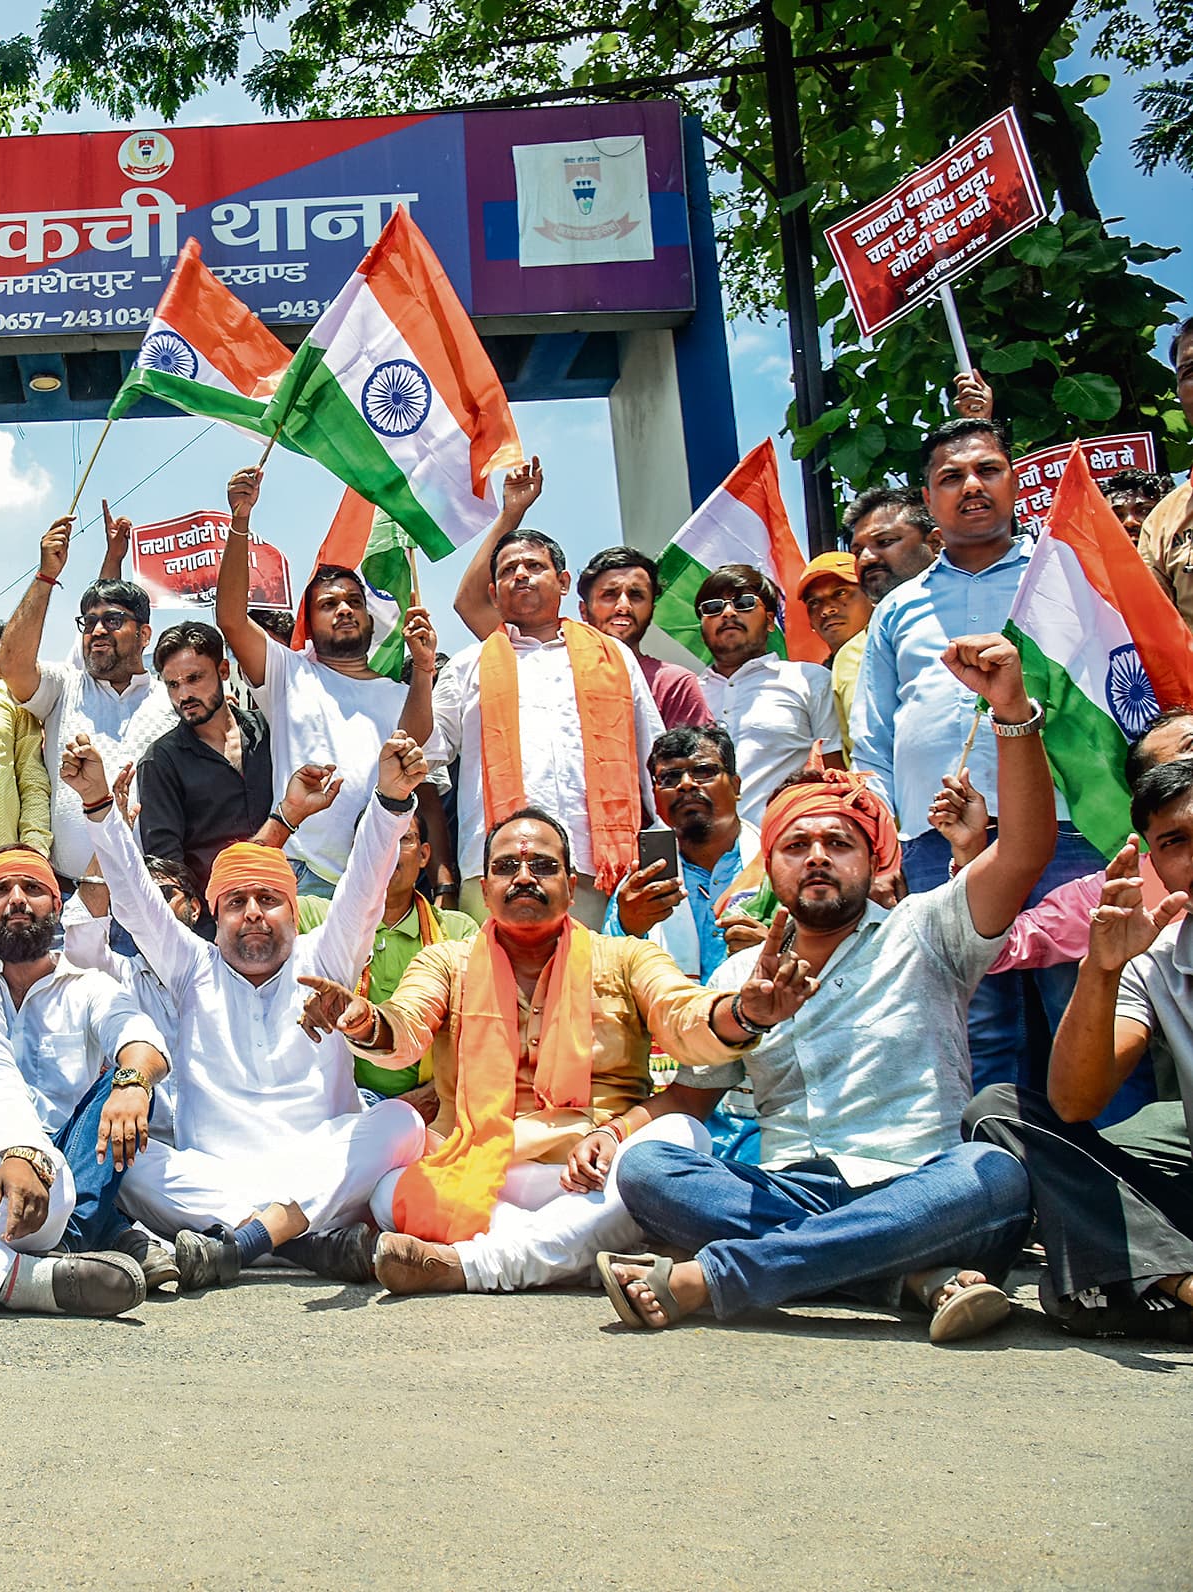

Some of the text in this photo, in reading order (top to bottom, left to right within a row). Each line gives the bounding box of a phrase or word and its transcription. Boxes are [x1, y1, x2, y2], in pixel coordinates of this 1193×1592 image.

[852, 199, 905, 247] साकची
[906, 173, 946, 210] थाना
[946, 151, 975, 182] क्षेत्र
[932, 219, 958, 245] बंद
[956, 194, 991, 228] करो
[865, 231, 896, 264] चल
[894, 215, 918, 245] रहे
[918, 192, 956, 228] अवैध
[905, 232, 989, 296] जन सुविधा मंच
[1090, 448, 1118, 470] क्षेत्र
[139, 535, 175, 556] नशा
[177, 521, 217, 549] खोरी
[164, 550, 216, 575] लगाना
